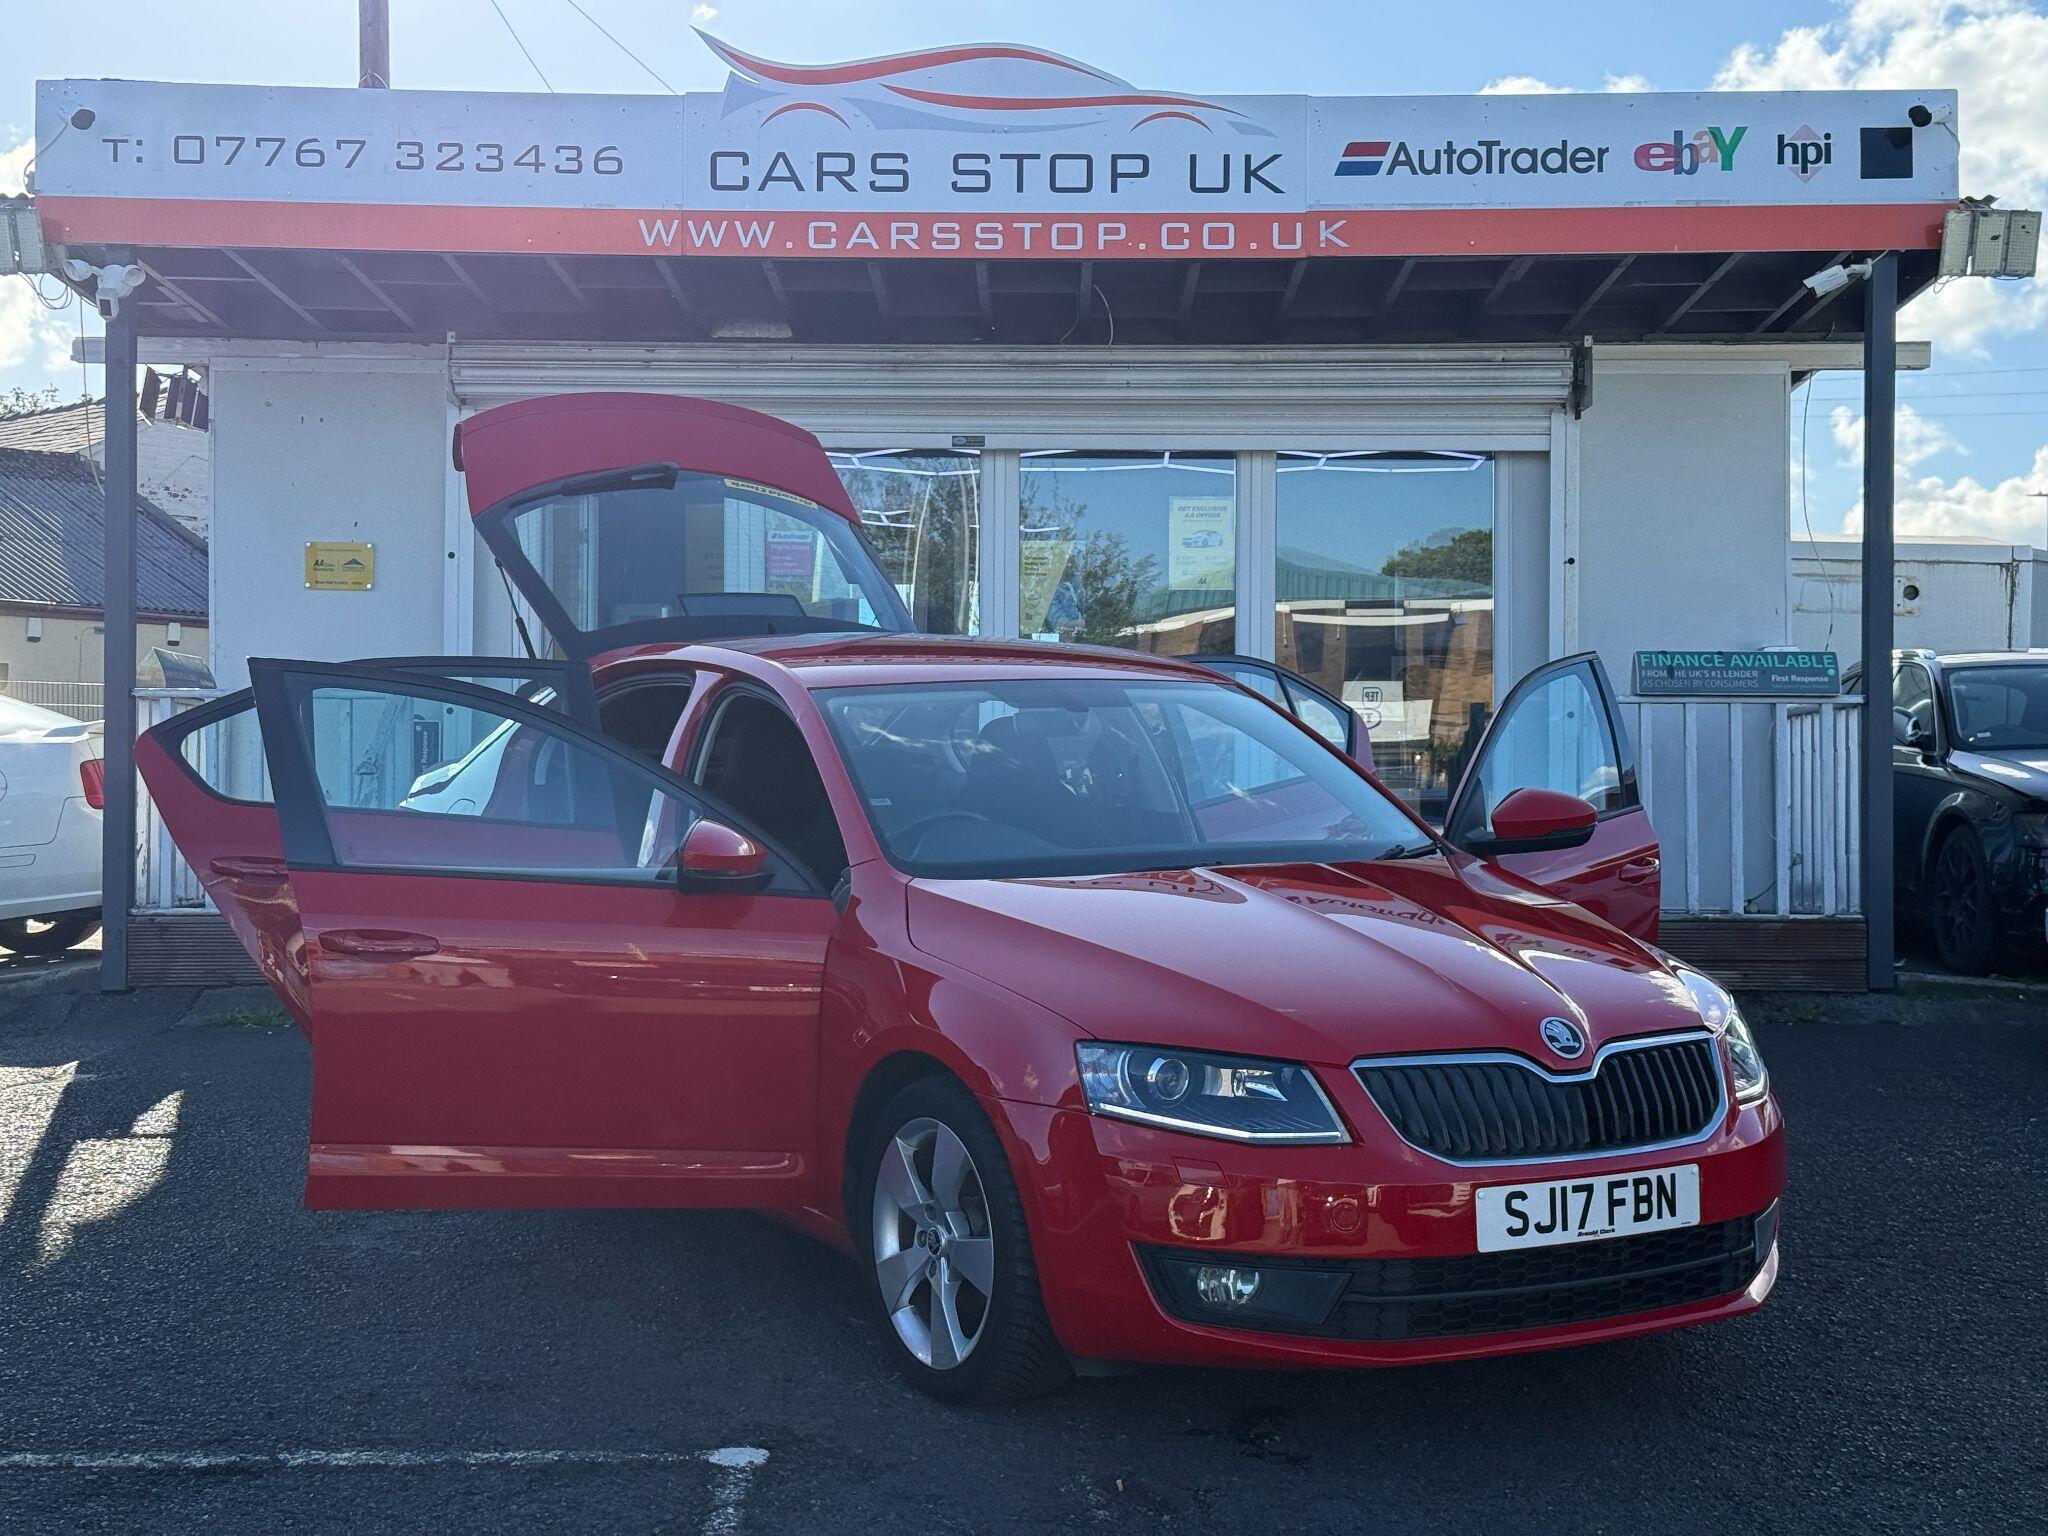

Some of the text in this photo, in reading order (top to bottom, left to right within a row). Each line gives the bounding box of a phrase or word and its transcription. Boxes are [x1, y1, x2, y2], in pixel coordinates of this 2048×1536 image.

[102, 134, 624, 176] T: 07767 323436
[1386, 140, 1609, 176] AutoTrader
[1777, 132, 1832, 174] hpi
[709, 150, 1285, 194] CARS STOP UK
[638, 219, 1349, 251] WWW.CARSSTOP.CO.UK
[1640, 653, 1836, 669] FINANCE AVAILABLE
[1641, 669, 1667, 678] FROM
[1688, 669, 1710, 678] UK'S
[1723, 669, 1759, 678] LENDER
[1641, 679, 1759, 688] AS CHOSEN BY CONSUMERS
[1771, 674, 1829, 684] First Response
[1504, 1172, 1677, 1237] SJ17 FBN
